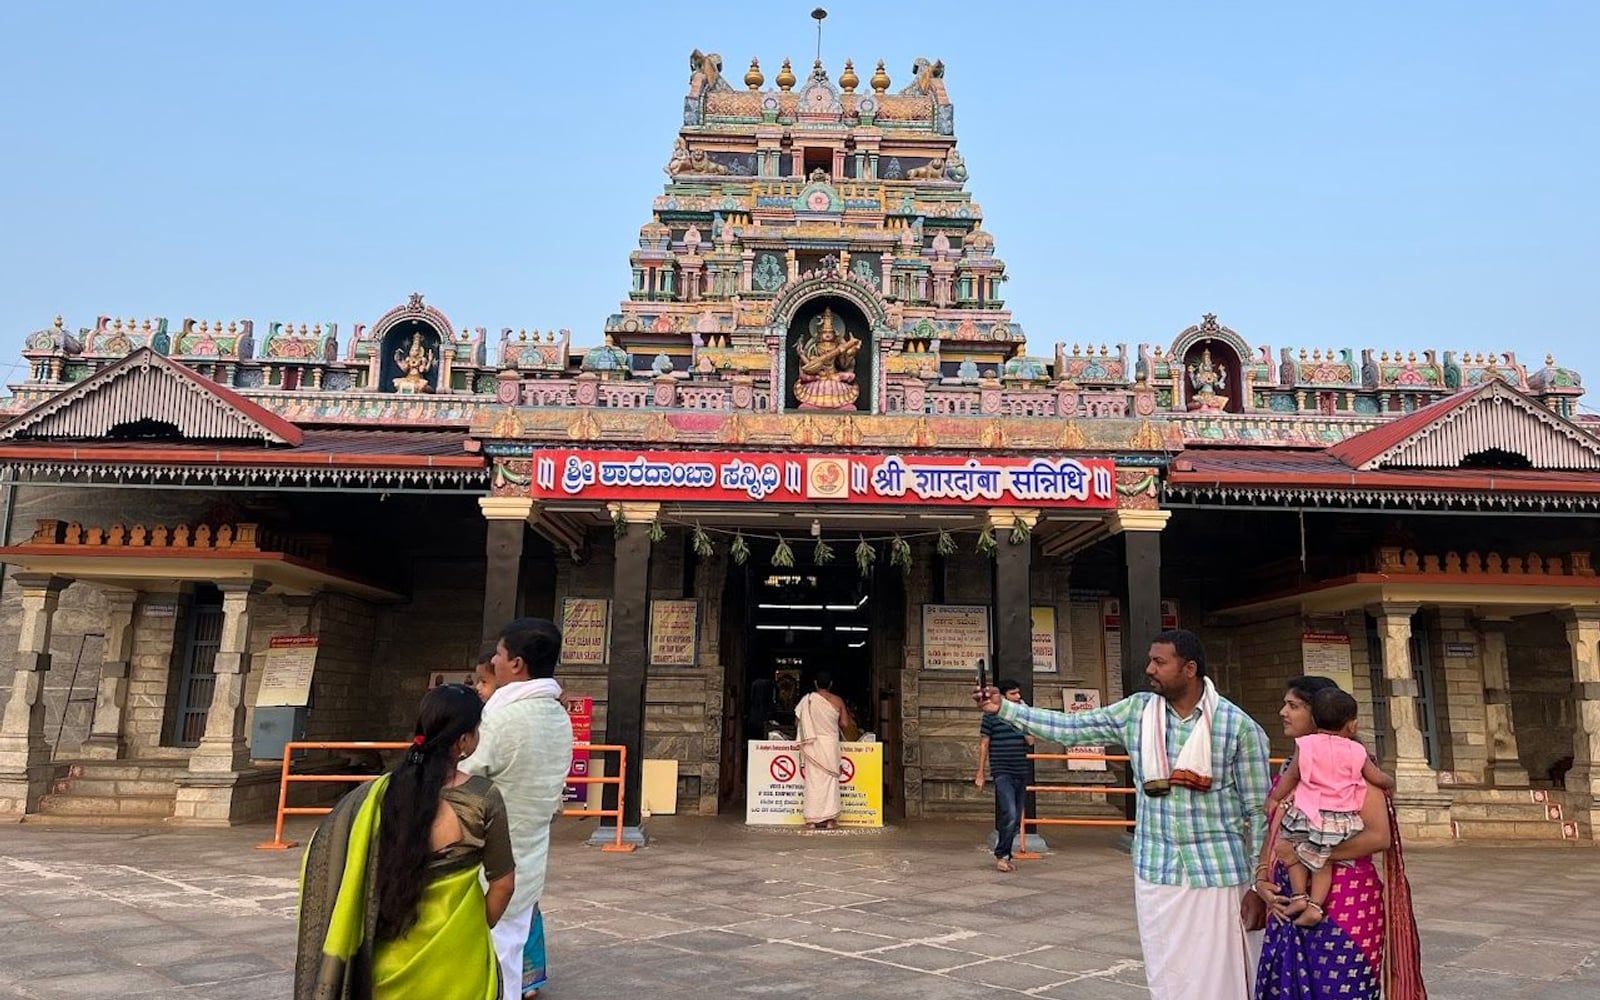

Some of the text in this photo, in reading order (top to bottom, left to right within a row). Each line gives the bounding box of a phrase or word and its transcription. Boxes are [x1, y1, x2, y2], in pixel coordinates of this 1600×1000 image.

[565, 457, 593, 491] ಶ್ರೀ
[601, 458, 714, 487] ಶಾರದಾಂಬಾ
[723, 459, 779, 497] ಸನ್ನಿಧಿ
[873, 460, 905, 496] श्री
[912, 462, 1002, 498] शारदांबा
[1009, 461, 1088, 498] सन्निधि
